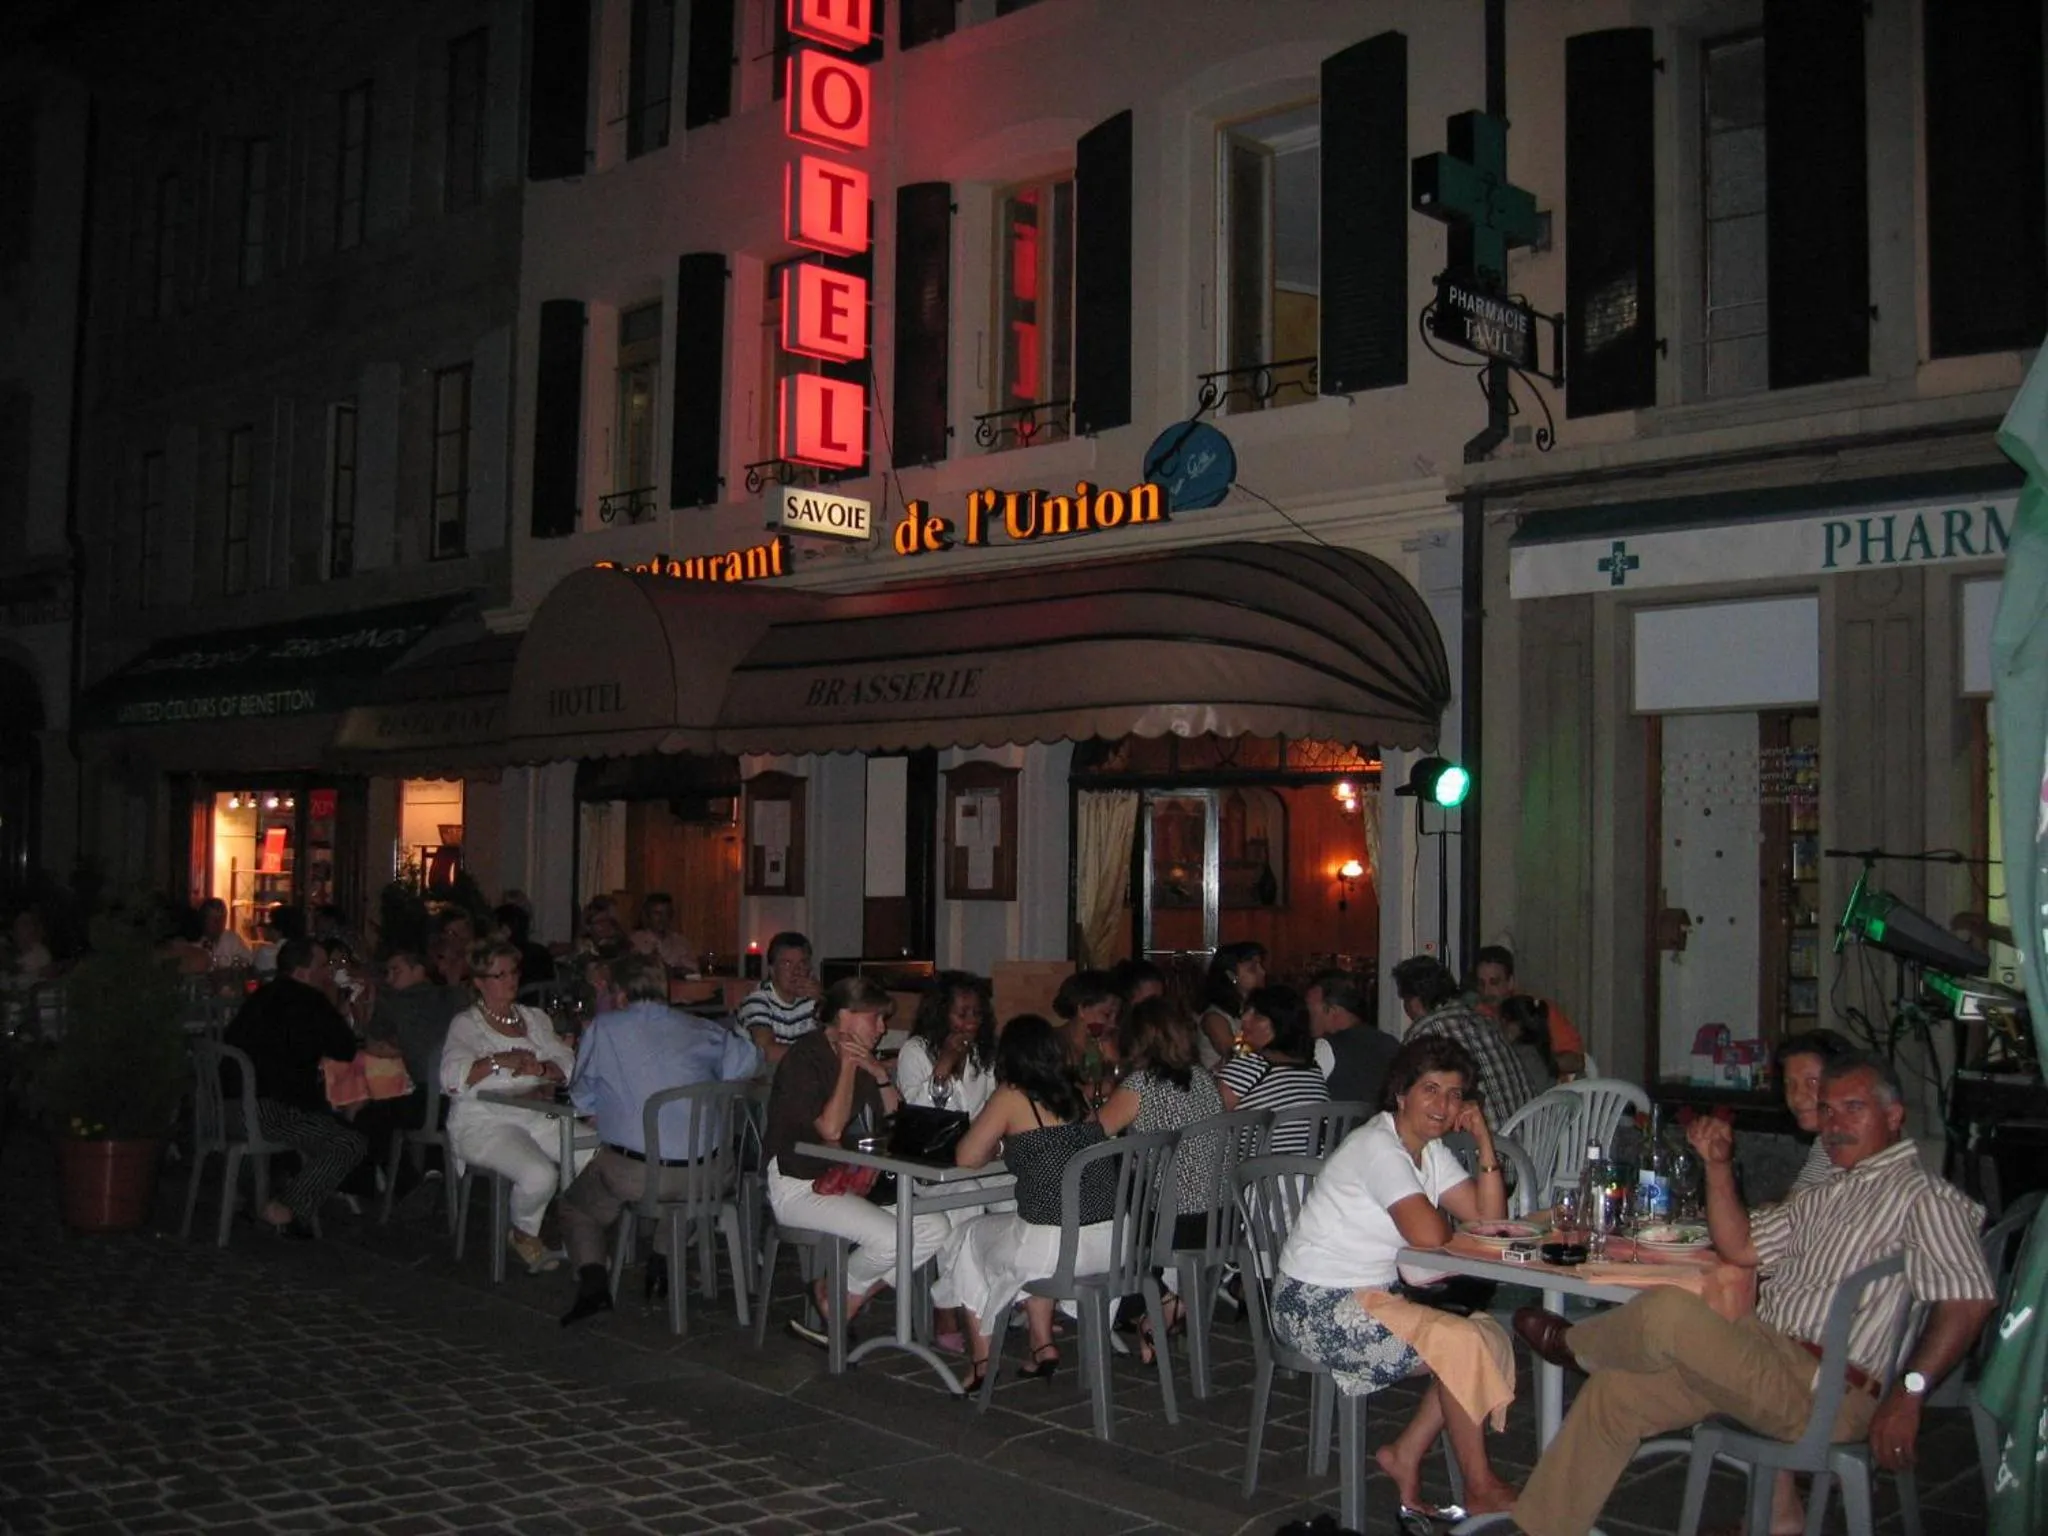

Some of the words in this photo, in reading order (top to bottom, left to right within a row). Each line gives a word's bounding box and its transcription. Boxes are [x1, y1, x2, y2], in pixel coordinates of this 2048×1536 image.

[1448, 284, 1529, 334] PHARMACIE
[593, 535, 784, 583] taurant
[894, 500, 947, 556] de
[966, 479, 1163, 548] l'Union
[786, 495, 867, 531] SAVOIE
[164, 697, 216, 721] COLORS
[219, 697, 239, 718] OF
[238, 689, 316, 716] BENETTON
[549, 682, 627, 718] HOTEL
[805, 667, 984, 707] BRASSERIE
